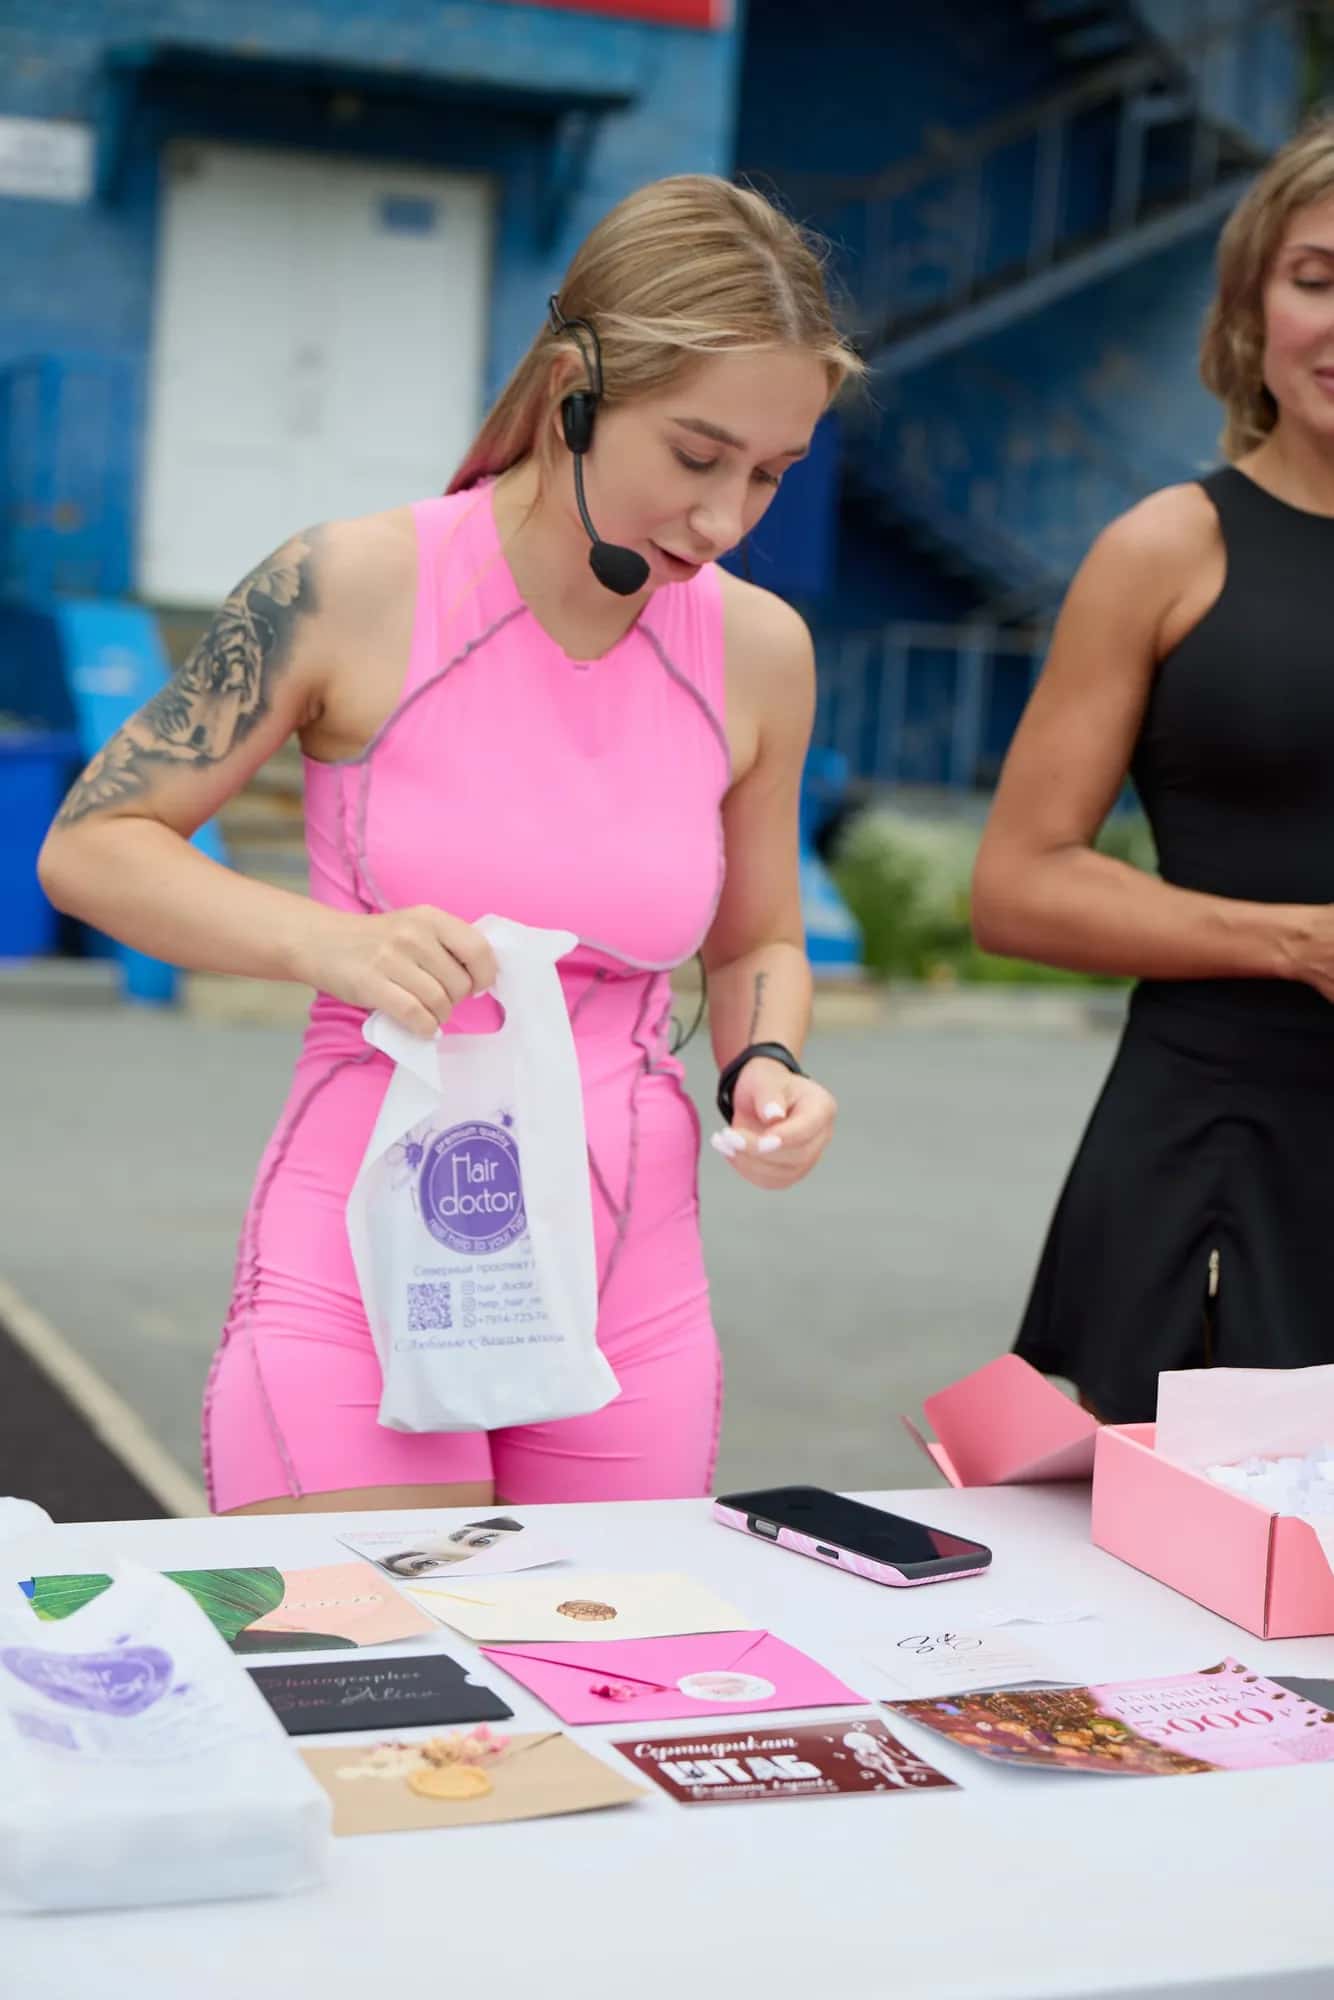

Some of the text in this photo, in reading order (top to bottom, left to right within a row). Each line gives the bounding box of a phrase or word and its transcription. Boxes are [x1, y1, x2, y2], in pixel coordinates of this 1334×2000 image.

[452, 1151, 499, 1184] Hair
[439, 1188, 516, 1216] doctor
[1133, 1706, 1275, 1736] 5000
[658, 1754, 823, 1786] ШТАБ
